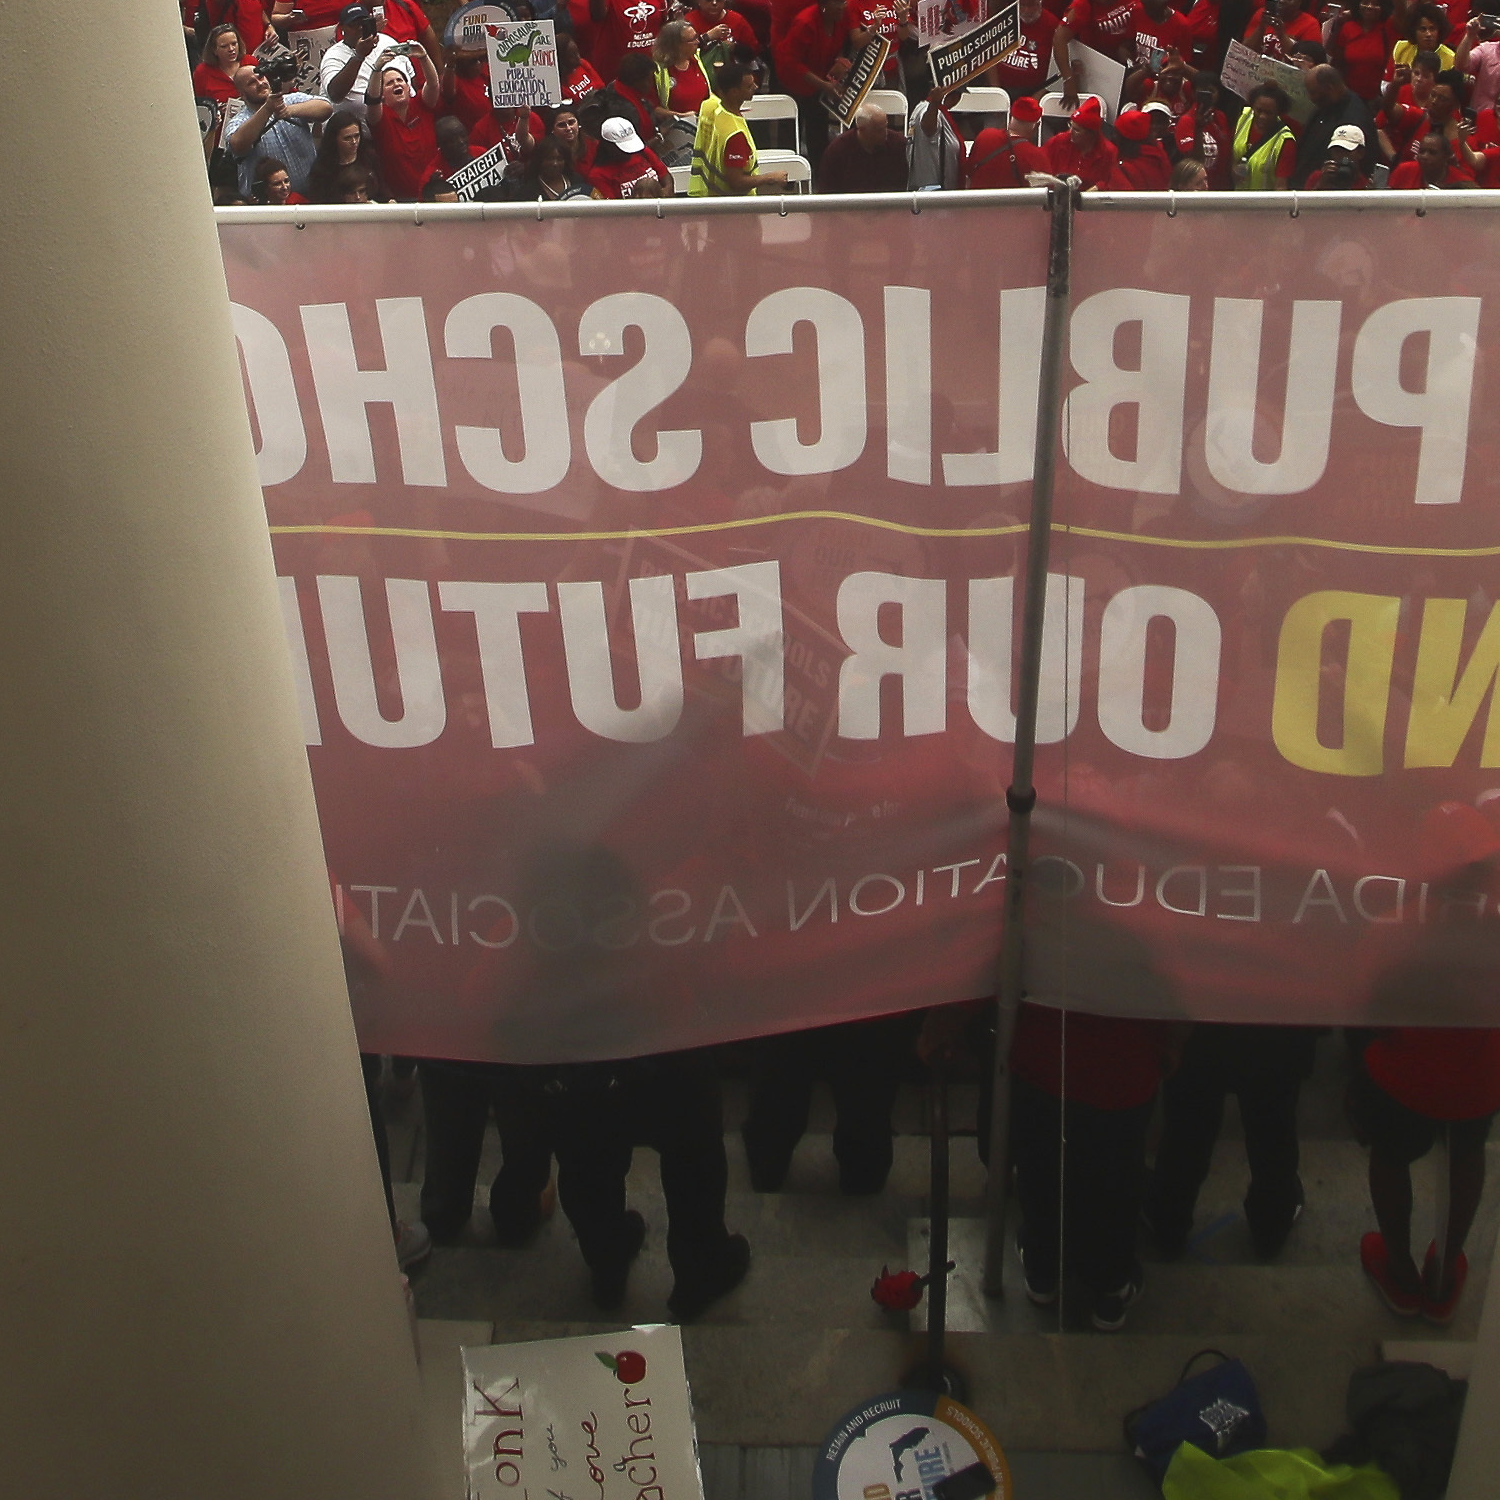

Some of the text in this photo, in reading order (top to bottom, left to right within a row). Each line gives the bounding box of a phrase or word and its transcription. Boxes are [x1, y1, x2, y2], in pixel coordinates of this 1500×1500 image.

[463, 13, 487, 26] FUND
[463, 25, 482, 37] OUR
[498, 21, 538, 56] DINOSAURS
[535, 34, 552, 47] ARE
[938, 14, 1014, 70] PUBLIC SCHOOLS
[1135, 31, 1158, 46] FUND
[942, 30, 1016, 90] OUR FUTURE
[498, 79, 546, 94] EDUCATION
[506, 68, 536, 81] PUBLIC
[569, 73, 591, 95] Fund
[839, 39, 883, 117] OUR FUTURE
[539, 92, 552, 104] BE
[826, 1397, 902, 1462] RETAIN AND RECRUIT
[946, 1404, 982, 1440] SCHOOLS
[472, 1377, 527, 1500] onK
[547, 1424, 568, 1472] you
